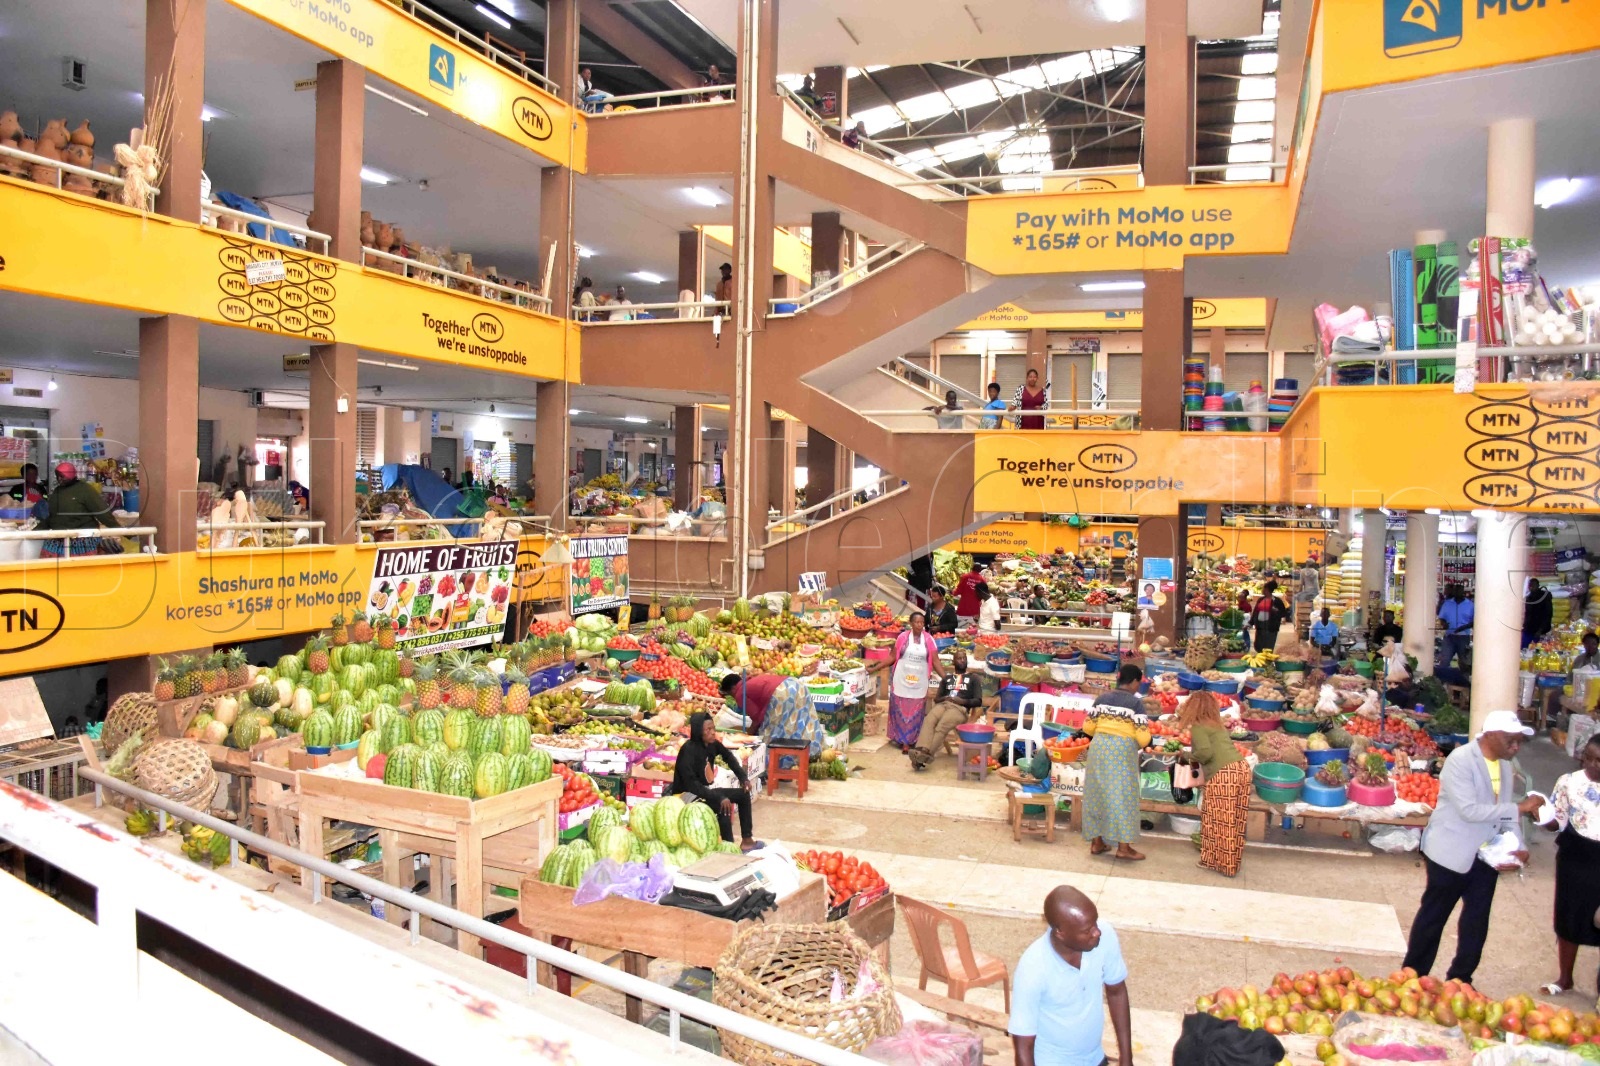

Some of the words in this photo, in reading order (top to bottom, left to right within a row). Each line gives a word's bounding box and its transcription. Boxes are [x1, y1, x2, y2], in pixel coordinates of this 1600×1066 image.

[308, 1, 347, 32] MoMo
[350, 26, 374, 48] app
[522, 111, 544, 131] MTN
[1016, 212, 1056, 231] Pay
[1062, 208, 1110, 226] with
[1118, 206, 1184, 224] MoMo
[1192, 208, 1232, 222] use
[1086, 234, 1109, 248] or
[1116, 230, 1182, 248] MoMo
[1189, 232, 1234, 250] app
[228, 254, 245, 266] MTN
[258, 249, 275, 260] MTN
[286, 268, 302, 278] MTN
[314, 263, 330, 273] MTN
[227, 279, 245, 290] MTN
[314, 286, 329, 296] MTN
[257, 298, 274, 308] MTN
[286, 292, 302, 302] MTN
[226, 304, 244, 316] MTN
[313, 309, 328, 319] MTN
[1194, 306, 1206, 314] TN
[285, 316, 302, 326] MTN
[422, 312, 470, 336] Together
[480, 321, 496, 334] MTN
[438, 337, 466, 352] we're
[469, 344, 526, 365] unstoppable
[1482, 414, 1520, 426] MTN
[1546, 431, 1588, 445] MTN
[1482, 448, 1519, 461] MTN
[997, 458, 1075, 474] Together
[1092, 453, 1123, 464] MTN
[1544, 467, 1585, 480] MTN
[1022, 475, 1068, 488] we're
[1073, 476, 1184, 492] unstoppable
[1480, 484, 1518, 497] MTN
[588, 538, 607, 557] FRUITS
[608, 537, 628, 556] CENTRE
[1309, 537, 1324, 546] Pa
[380, 549, 432, 577] HOME
[436, 547, 460, 571] OF
[463, 544, 516, 568] FRUITS
[516, 562, 536, 577] MTN
[199, 575, 273, 594] Shashura
[278, 576, 295, 588] na
[300, 570, 338, 586] MoMo
[166, 603, 222, 620] koresa
[277, 597, 292, 609] or
[296, 591, 334, 608] MoMo
[338, 590, 362, 606] app
[1, 608, 38, 633] TN
[431, 634, 443, 644] 037
[448, 631, 464, 640] +256
